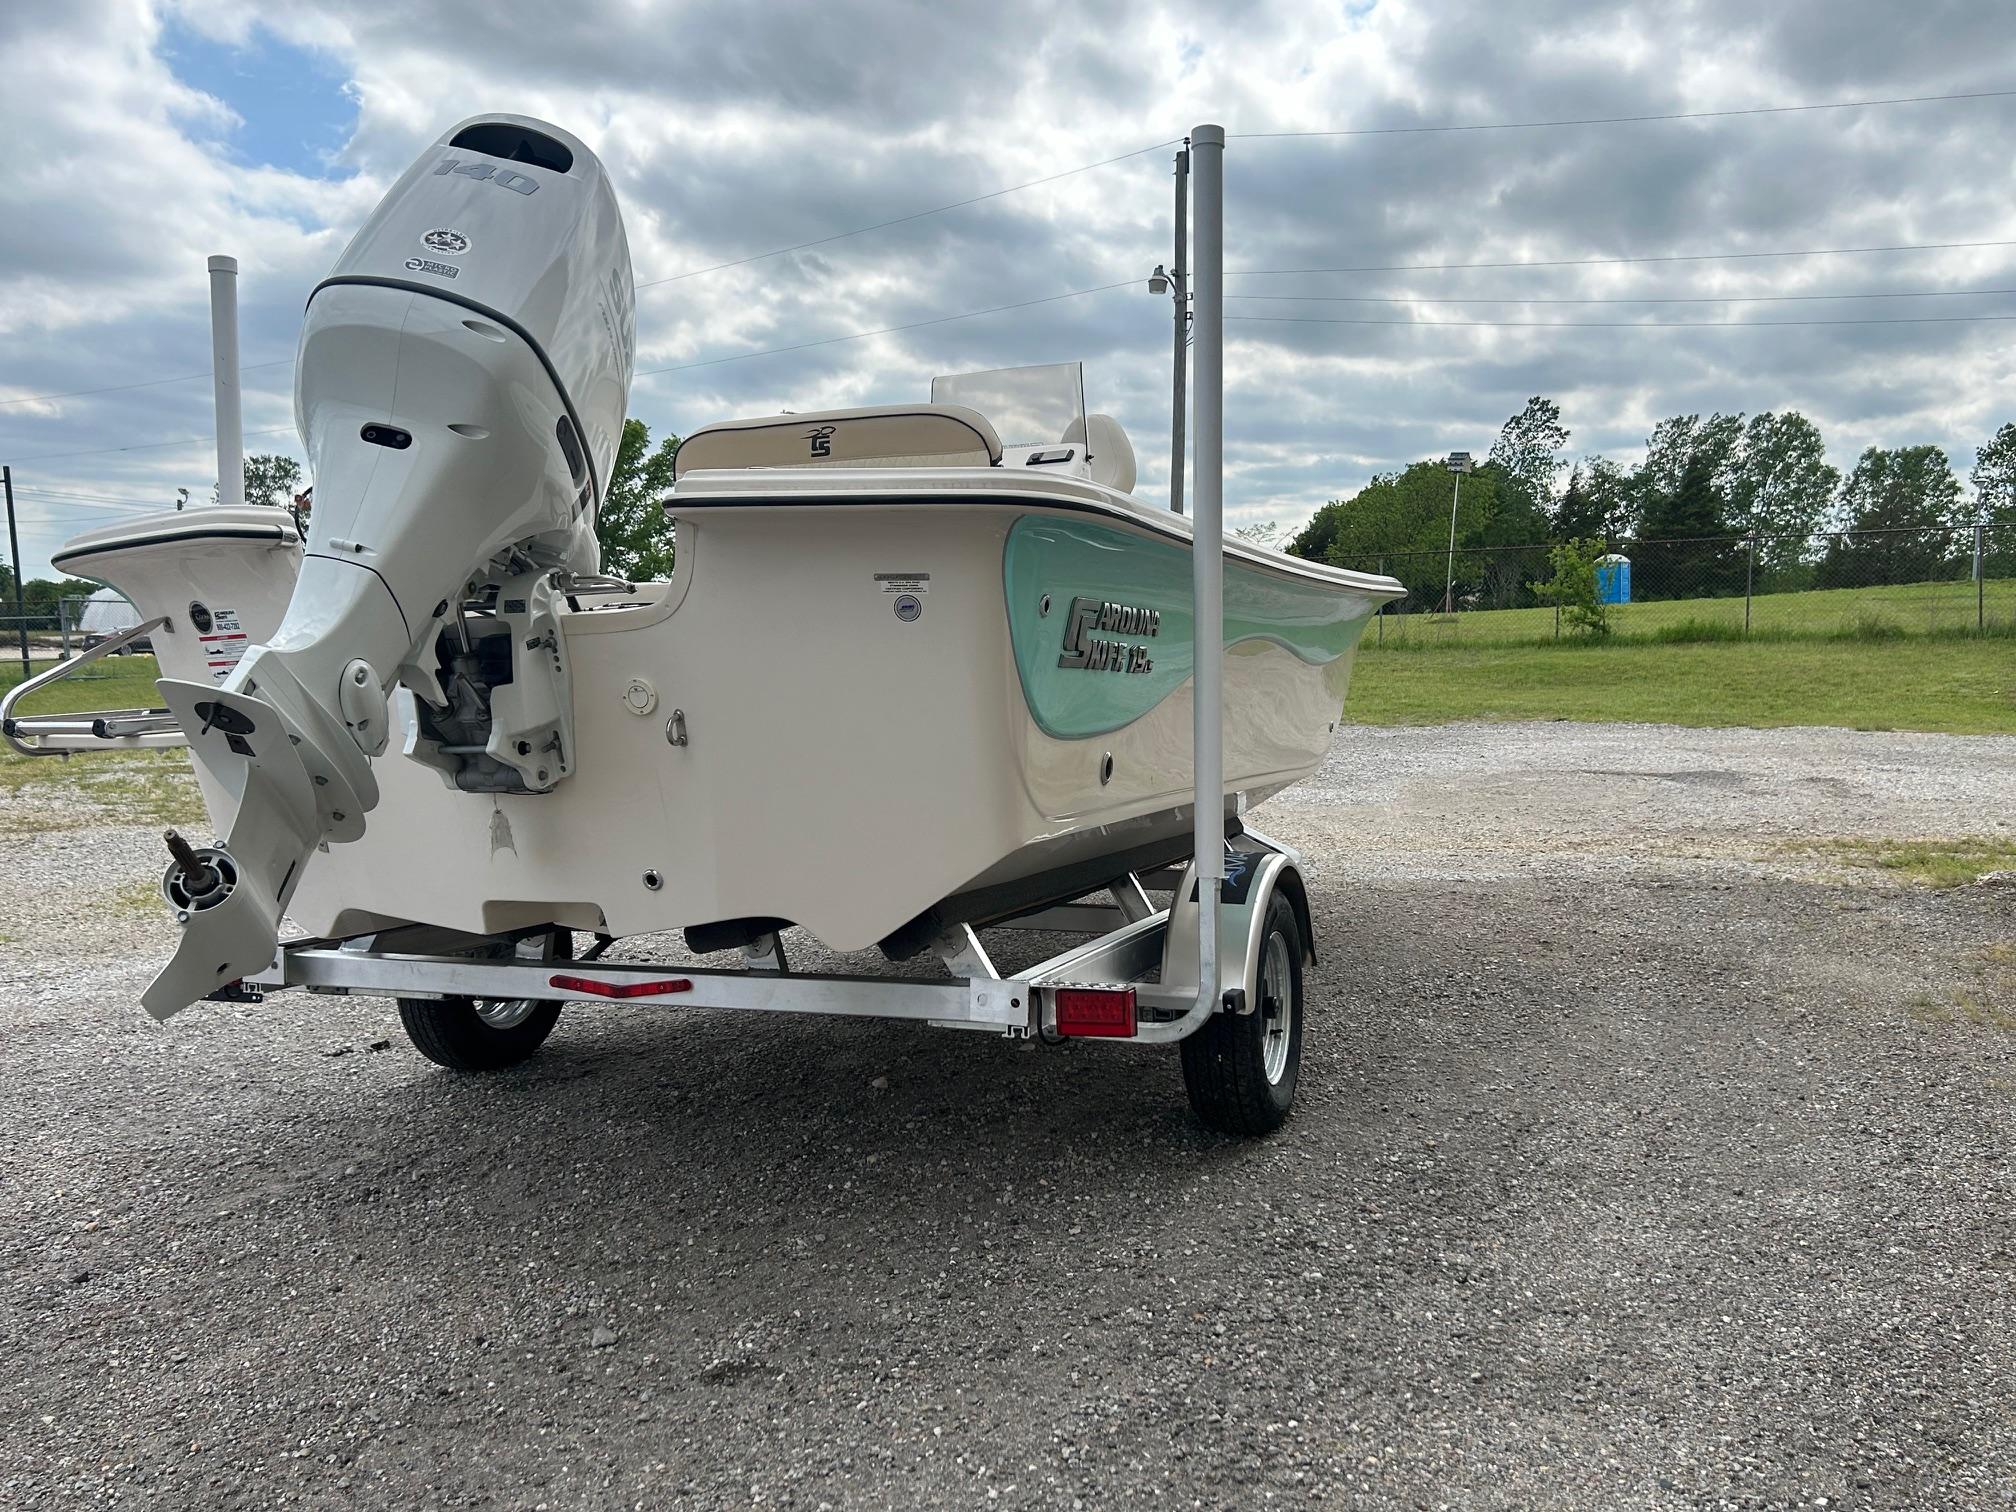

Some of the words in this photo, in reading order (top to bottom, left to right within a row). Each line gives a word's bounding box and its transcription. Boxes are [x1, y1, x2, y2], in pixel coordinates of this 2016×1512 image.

[433, 159, 540, 195] 140
[1058, 615, 1128, 672] SKIFF
[1063, 596, 1160, 652] CAROLINA
